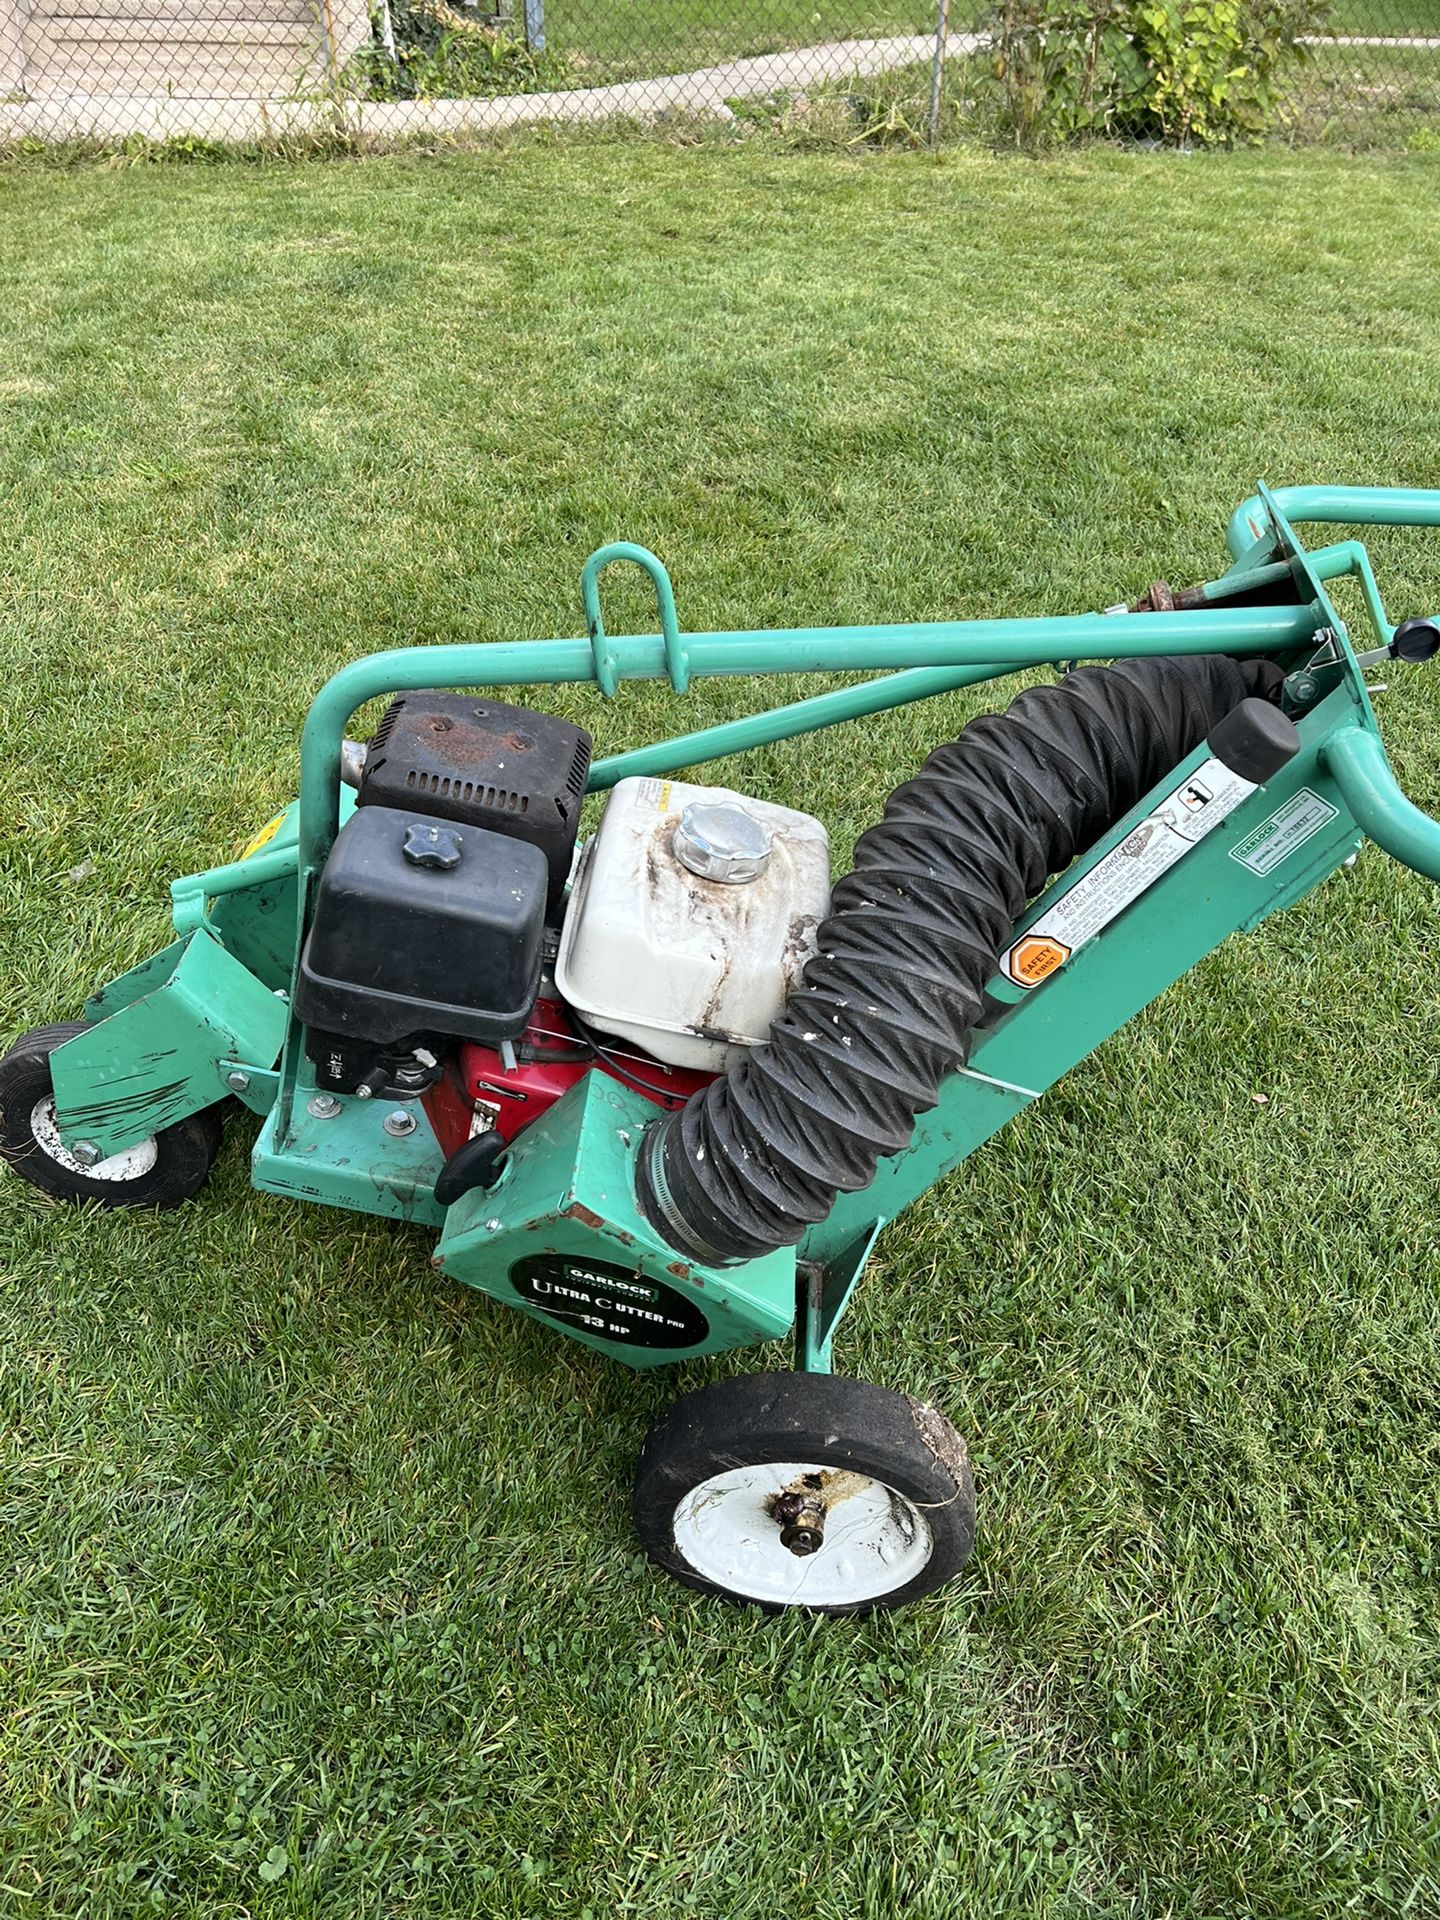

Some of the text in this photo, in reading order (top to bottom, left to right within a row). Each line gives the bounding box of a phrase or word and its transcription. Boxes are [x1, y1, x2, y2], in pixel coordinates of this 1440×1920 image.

[1239, 823, 1275, 856] GARLOCK
[1254, 846, 1274, 863] SERIAL
[1055, 885, 1087, 915] SAFETY
[1087, 833, 1142, 886] INFORMATION
[1062, 907, 1076, 921] AND
[1073, 869, 1117, 910] INSTRUCTIONS
[1021, 946, 1051, 975] SAFETY
[1034, 955, 1056, 976] FIRST
[570, 1269, 652, 1297] GARLOCK
[531, 1278, 685, 1329] ULTRA CUTTER PRO
[582, 1314, 631, 1335] 13 HP
